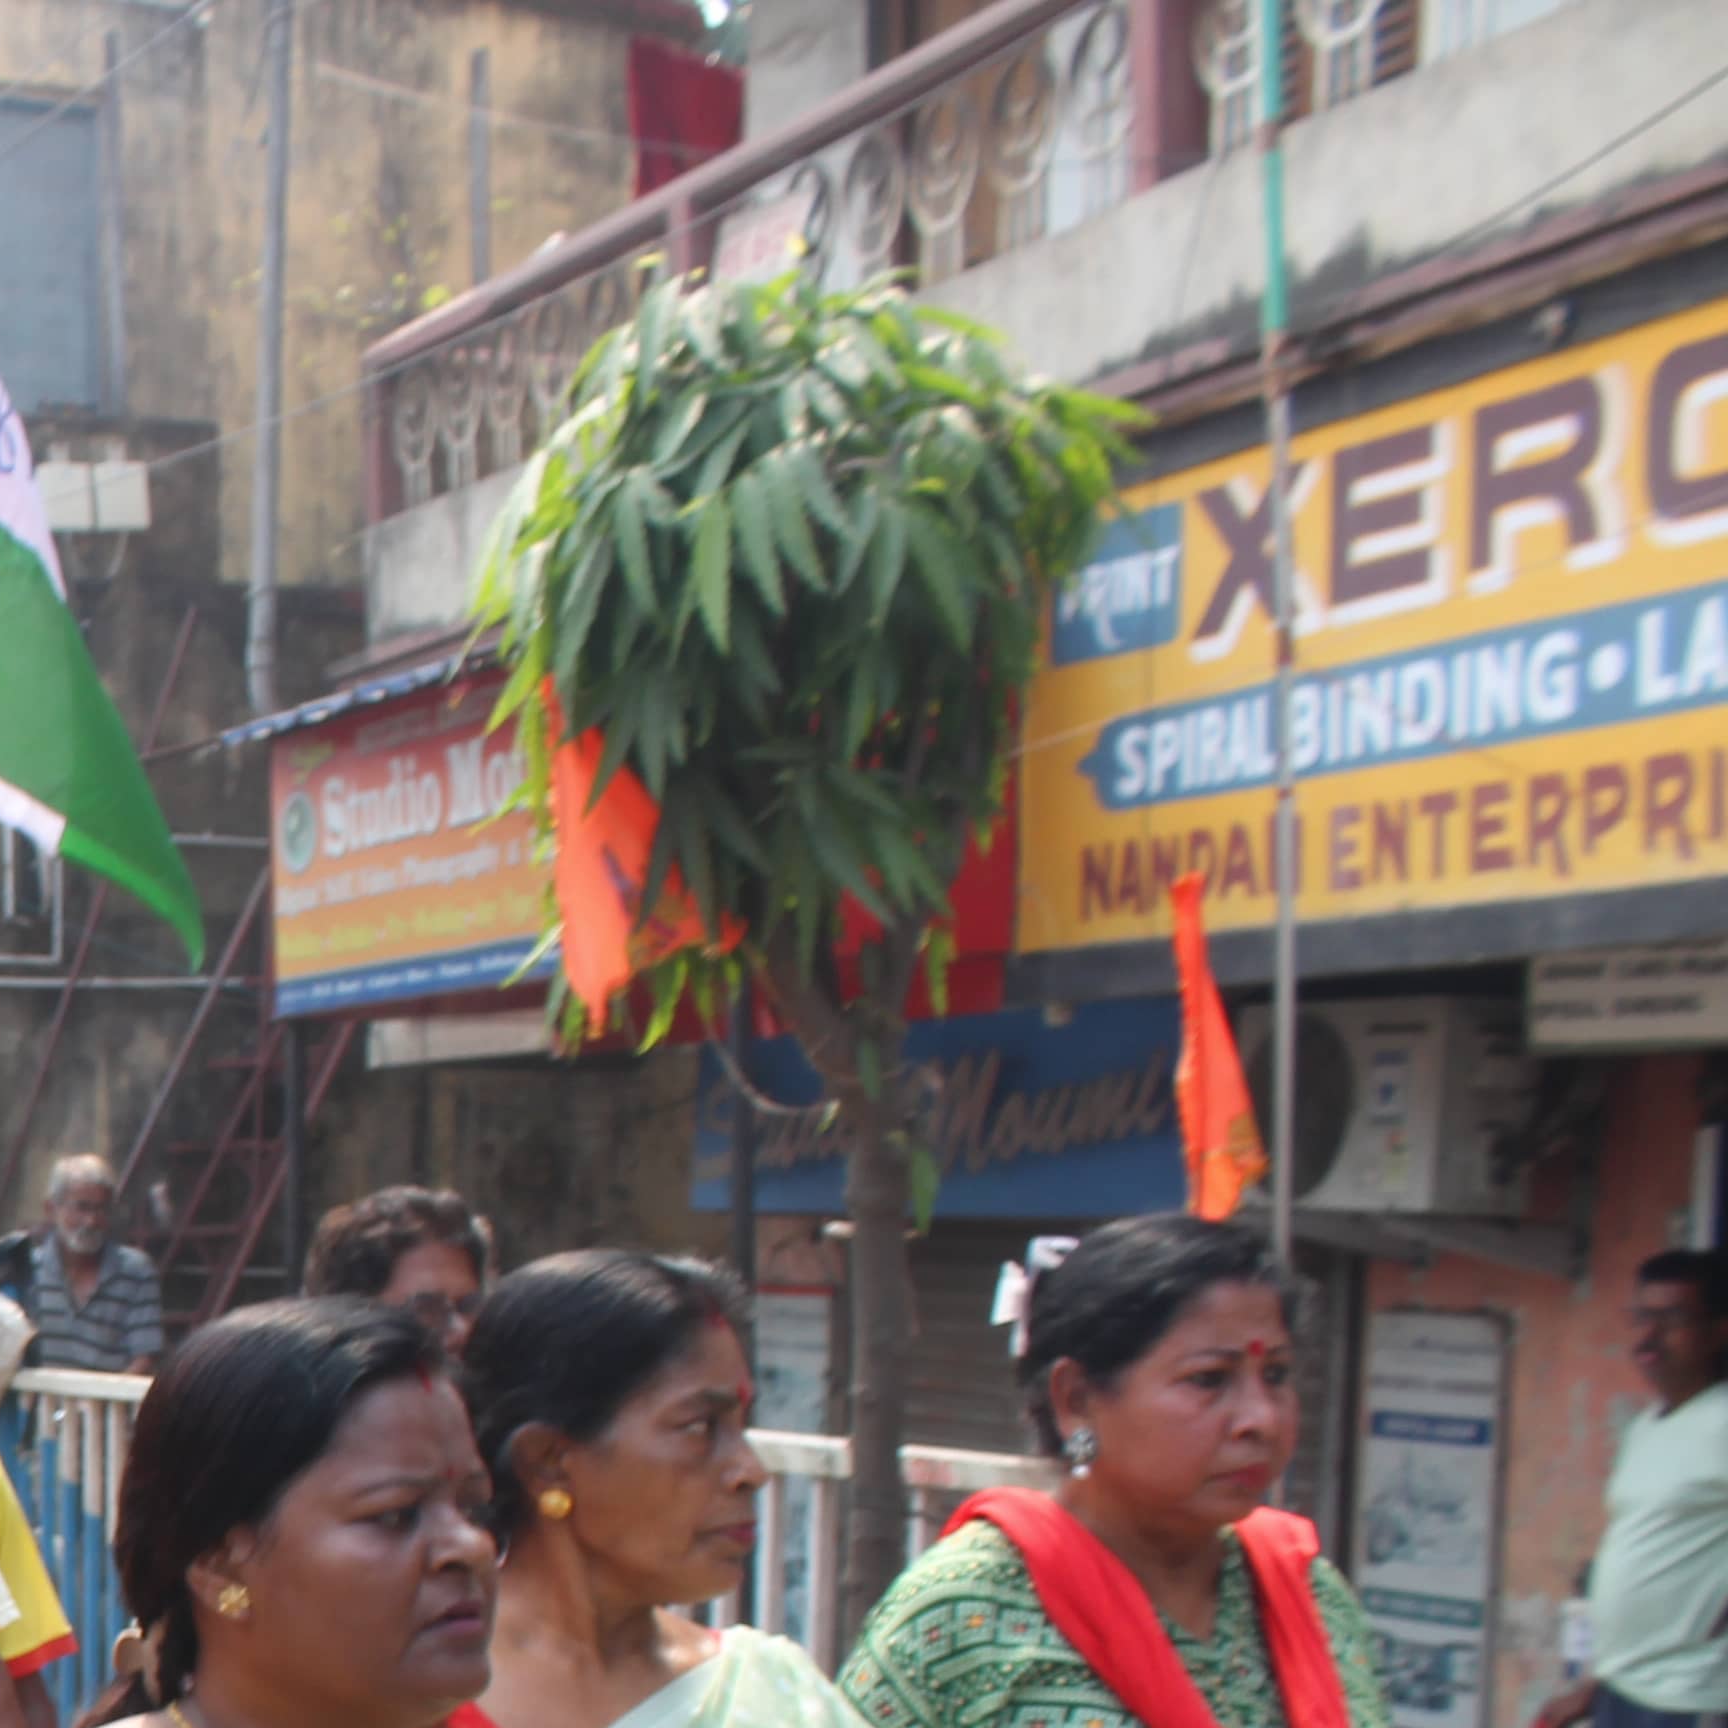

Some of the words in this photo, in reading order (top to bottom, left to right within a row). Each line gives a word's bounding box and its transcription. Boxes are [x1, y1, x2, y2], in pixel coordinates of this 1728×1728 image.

[1114, 692, 1277, 800] SPIRAL
[1290, 630, 1584, 772] BINDING
[320, 756, 442, 858] Studio
